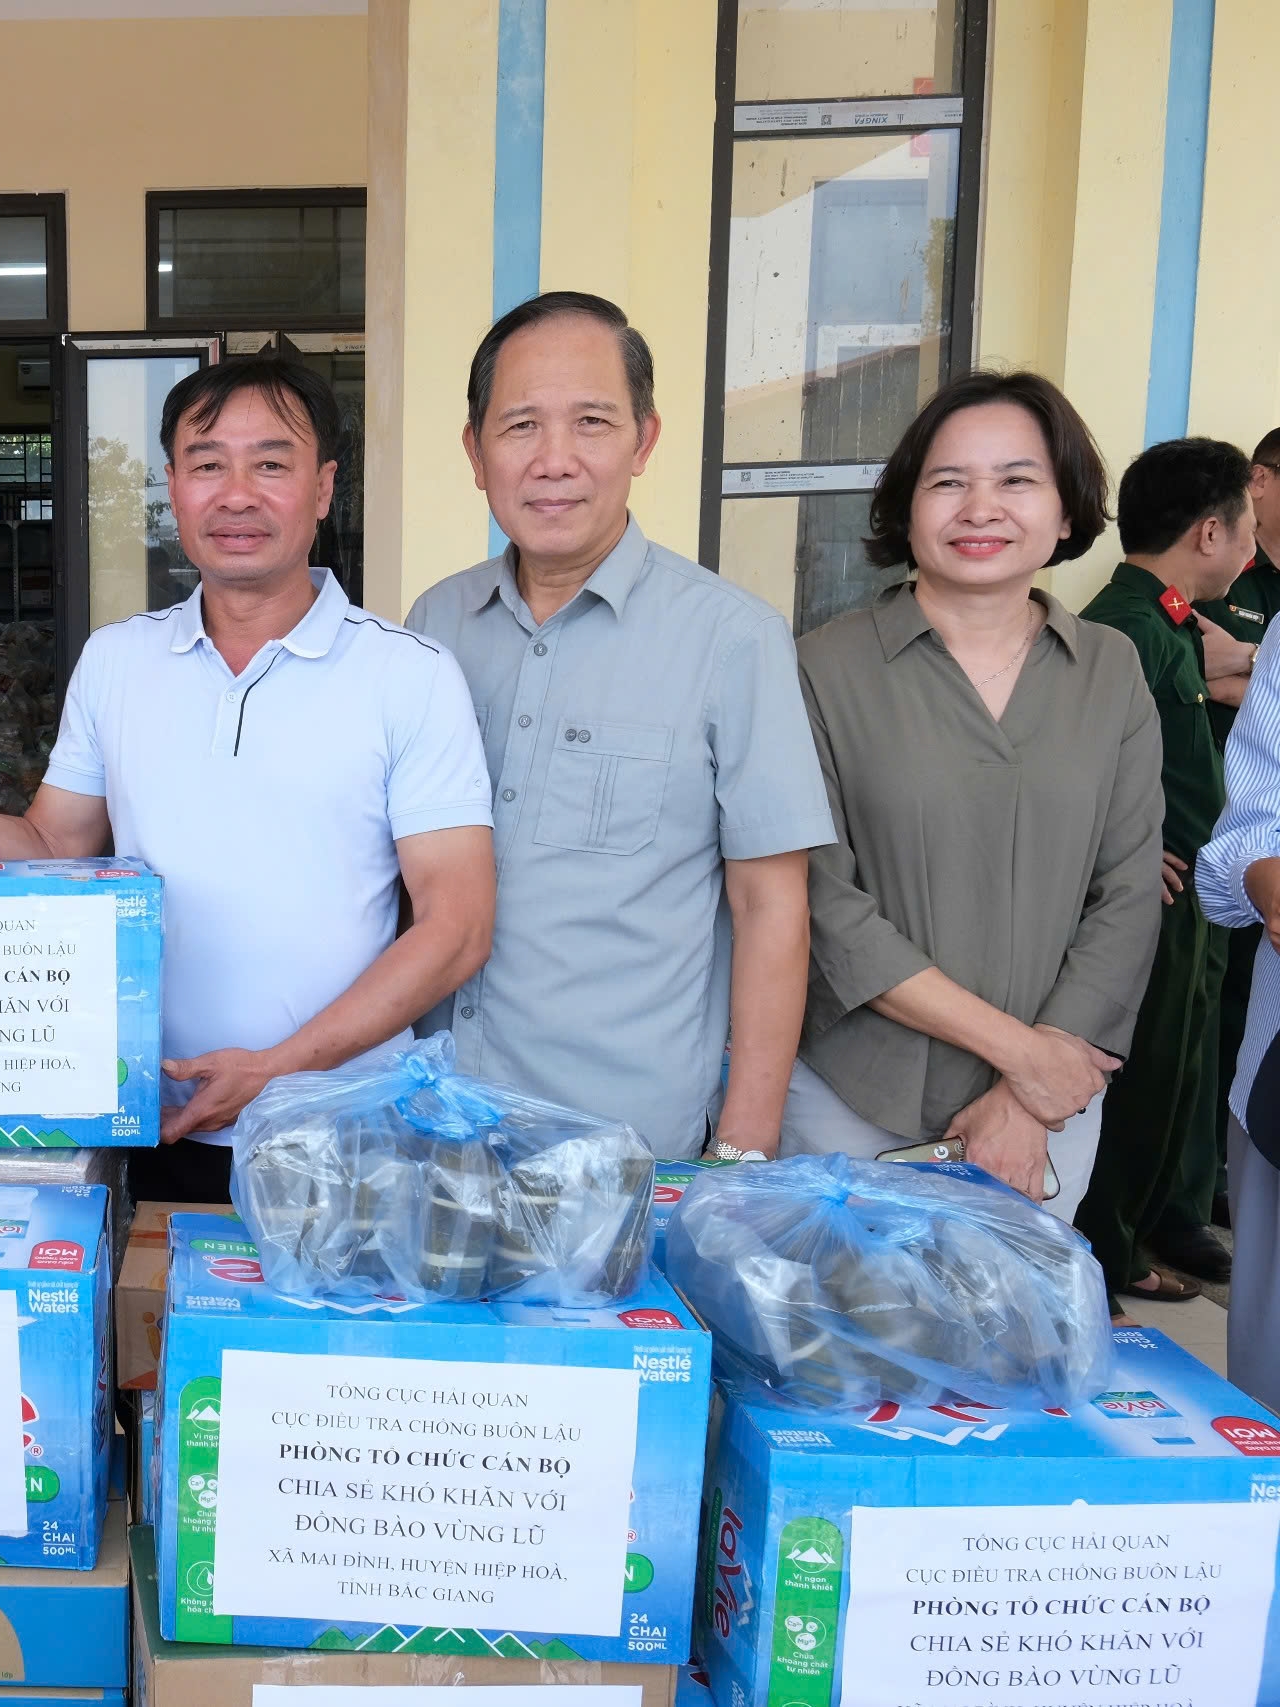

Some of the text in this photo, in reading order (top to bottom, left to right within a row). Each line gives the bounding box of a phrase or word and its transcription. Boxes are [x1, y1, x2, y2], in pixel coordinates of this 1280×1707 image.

[854, 116, 889, 125] XINGFA
[116, 895, 147, 907] estlé
[116, 907, 147, 917] aters
[5, 966, 40, 983] CÁN
[37, 995, 70, 1013] VỚI
[31, 1025, 56, 1043] LŨ
[111, 1115, 140, 1125] CHAI
[111, 1128, 141, 1137] 500ML
[28, 1288, 79, 1302] Nestlé
[28, 1302, 79, 1314] Waters
[633, 1353, 692, 1370] Nestlé
[386, 1387, 426, 1405] CỤC
[472, 1392, 528, 1410] QUAN
[271, 1411, 309, 1428] CỤC
[366, 1416, 402, 1432] TRA
[280, 1441, 361, 1463] PHÒNG
[407, 1448, 475, 1469] CHỨC
[482, 1451, 532, 1472] CÁN
[278, 1477, 338, 1498] CHIA
[382, 1481, 435, 1503] KHÓ
[443, 1485, 514, 1508] KHĂN
[523, 1489, 568, 1512] VỚI
[42, 1521, 59, 1531] 24
[374, 1515, 425, 1539] BÀO
[433, 1518, 504, 1543] VÙNG
[513, 1524, 545, 1546] LŨ
[42, 1533, 75, 1543] CHAI
[42, 1546, 77, 1556] 500ML
[268, 1547, 295, 1564] XÃ
[301, 1550, 337, 1566] MAI
[344, 1552, 395, 1571] ĐÌNH,
[432, 1587, 495, 1604] GIANG
[912, 1596, 999, 1616] PHÒNG
[1045, 1594, 1115, 1615] CHỨC
[1122, 1592, 1171, 1614] CÁN
[629, 1612, 648, 1624] 24
[629, 1626, 667, 1637] CHAI
[910, 1634, 973, 1653] CHIA
[1018, 1630, 1072, 1652] KHÓ
[1080, 1630, 1153, 1651] KHĂN
[1160, 1625, 1205, 1649] VỚI
[628, 1641, 668, 1652] 500ML
[1008, 1665, 1061, 1687] BÀO
[1069, 1664, 1141, 1685] VÙNG
[1149, 1664, 1181, 1685] LŨ
